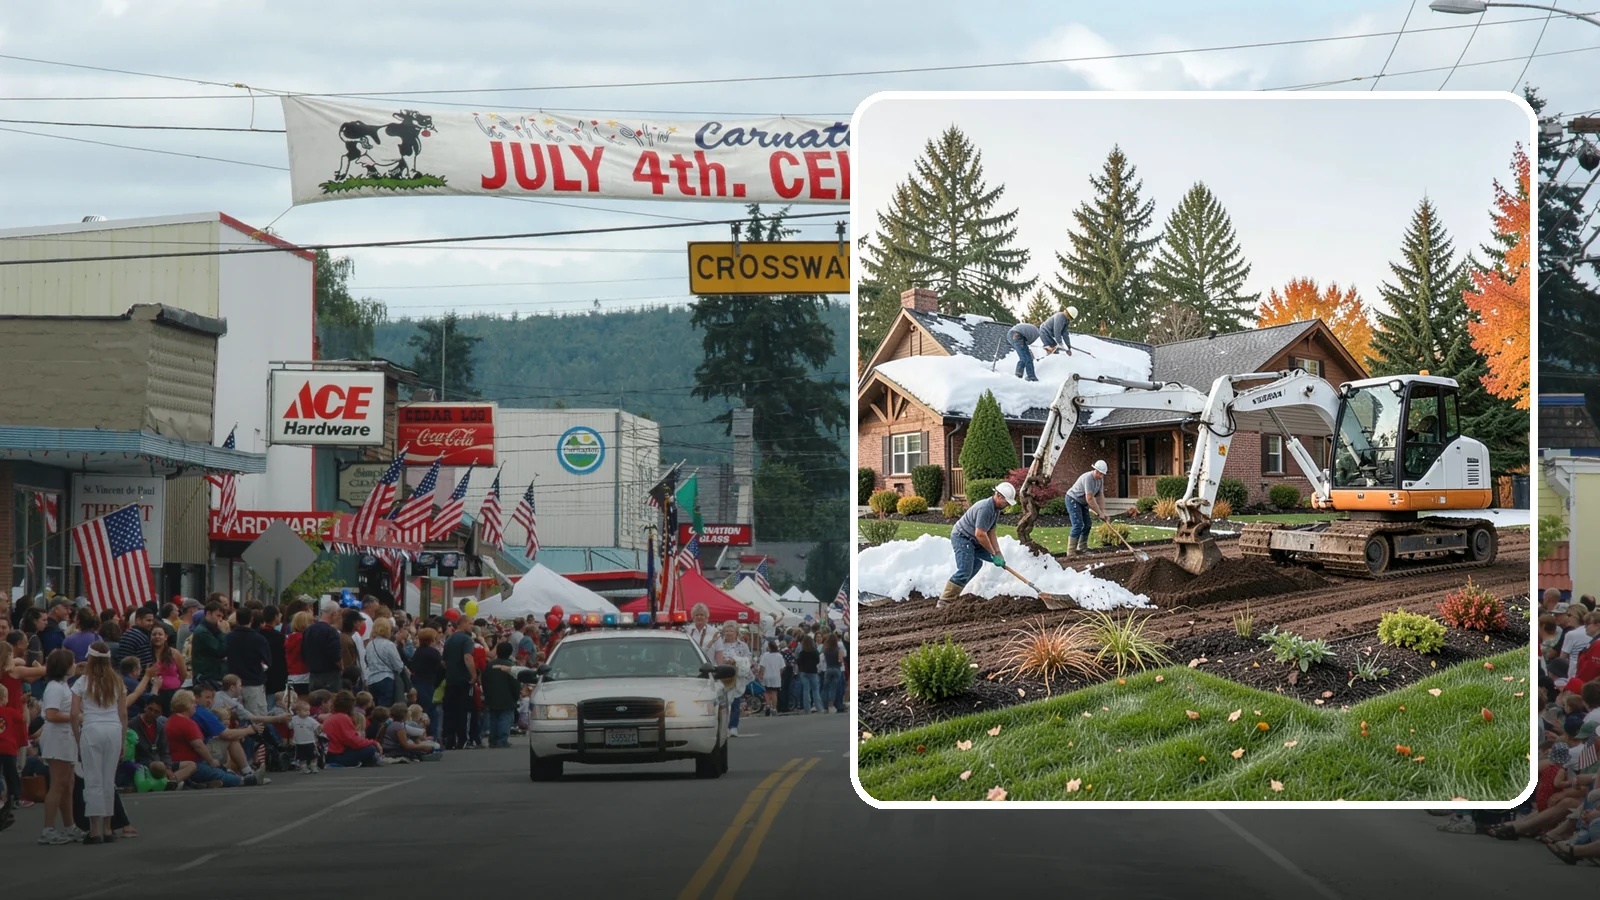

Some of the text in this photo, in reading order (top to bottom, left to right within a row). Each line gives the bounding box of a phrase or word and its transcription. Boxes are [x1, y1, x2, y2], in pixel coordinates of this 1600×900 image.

[481, 141, 605, 193] JULY
[632, 150, 746, 198] 4th.
[697, 254, 850, 280] CROSSWA
[282, 380, 374, 420] ACE
[405, 409, 452, 422] CEDAR
[283, 421, 371, 436] Hardware
[416, 428, 477, 447] Coca-Cola
[353, 467, 388, 480] Simpl
[95, 485, 124, 495] Vincent
[126, 486, 136, 495] de
[137, 486, 155, 495] Paul
[81, 503, 154, 522] THT
[212, 516, 331, 535] HARDARE
[688, 526, 741, 535] CRNATION
[699, 535, 730, 543] GLASS
